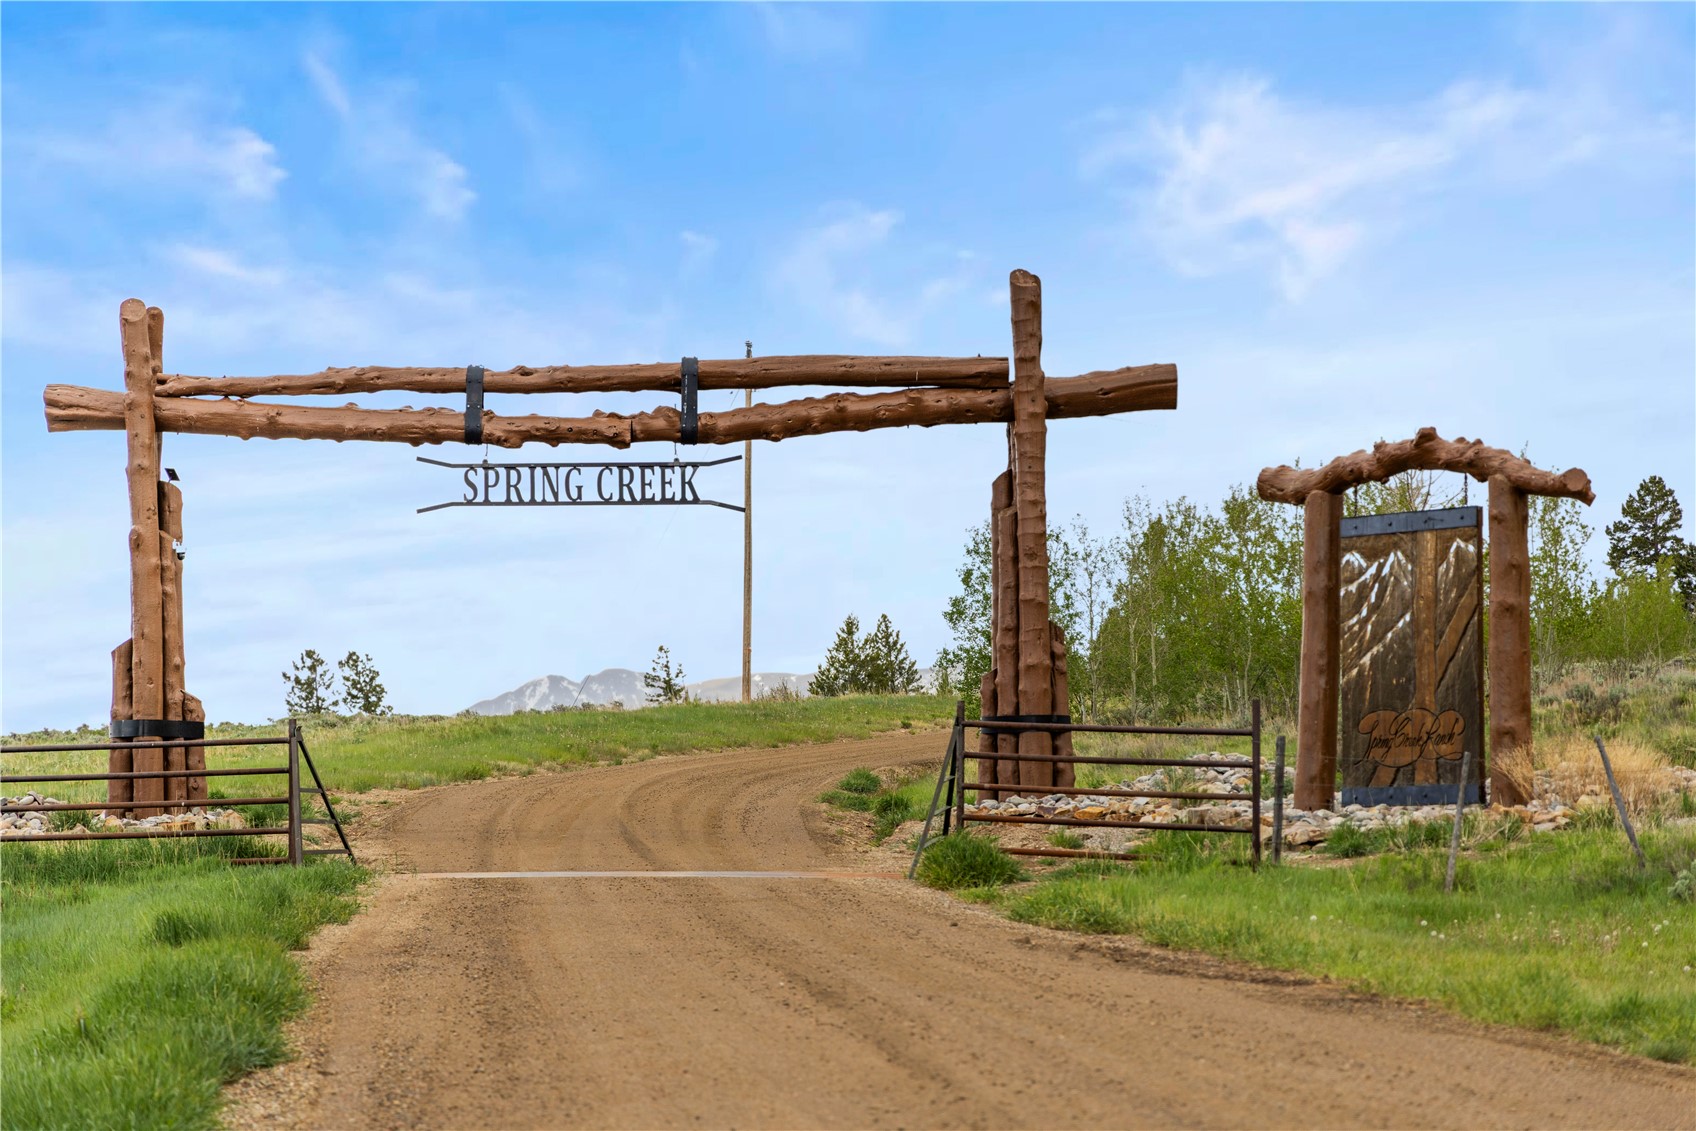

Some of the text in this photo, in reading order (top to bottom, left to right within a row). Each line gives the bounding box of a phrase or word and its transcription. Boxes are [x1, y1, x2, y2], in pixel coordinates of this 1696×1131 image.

[463, 466, 700, 502] SPRING CREEK
[1355, 710, 1398, 765] Spring
[1419, 709, 1465, 761] Ranch
